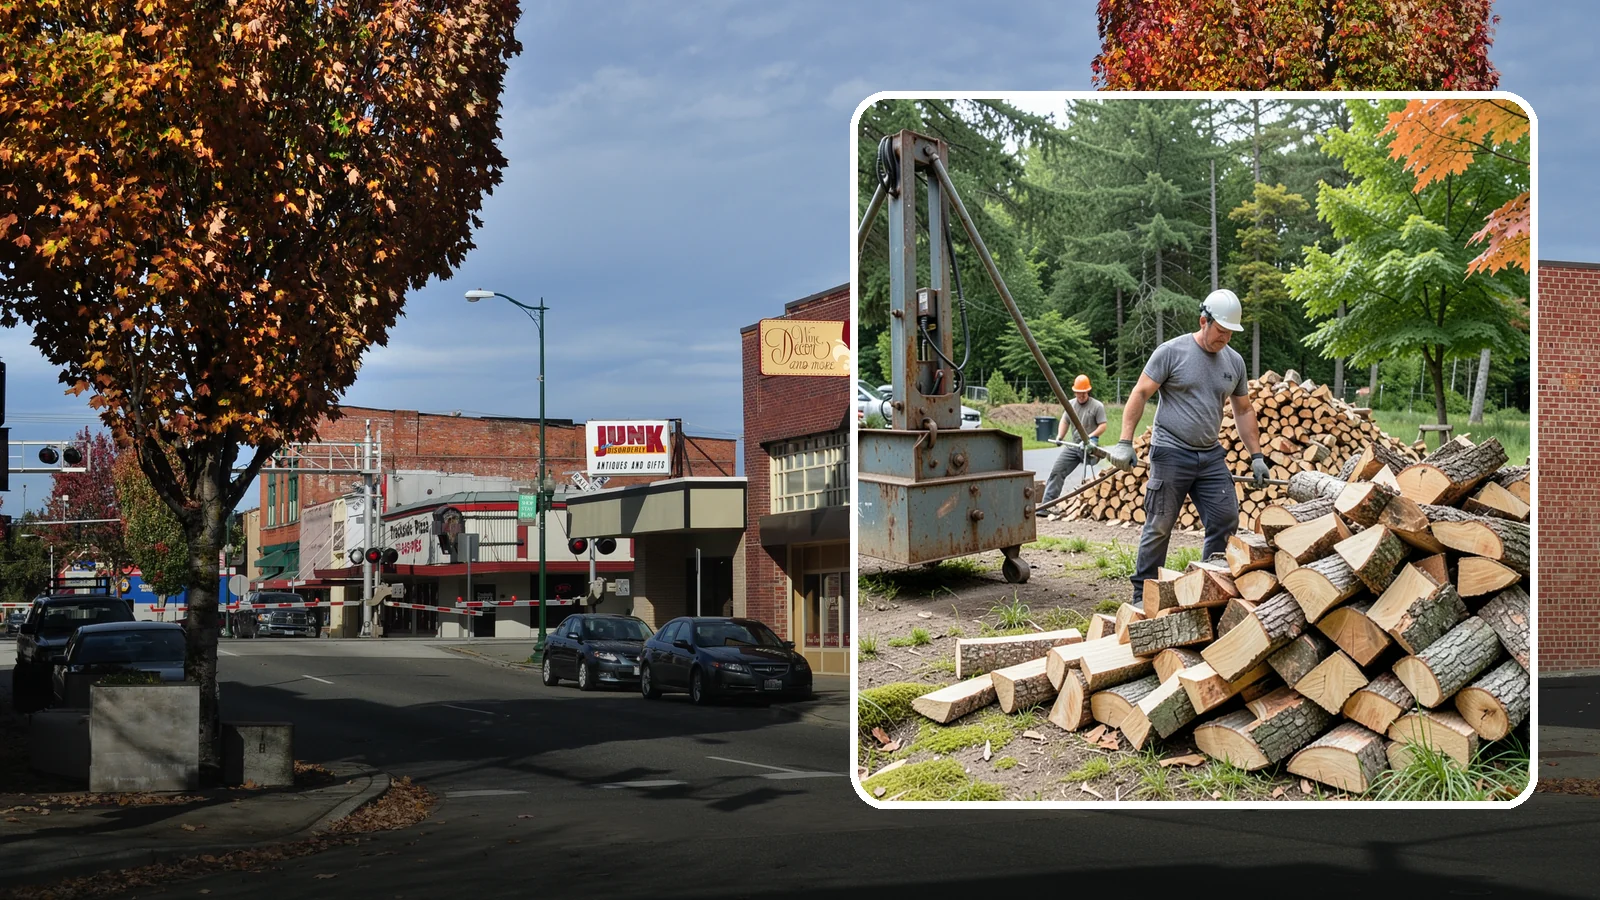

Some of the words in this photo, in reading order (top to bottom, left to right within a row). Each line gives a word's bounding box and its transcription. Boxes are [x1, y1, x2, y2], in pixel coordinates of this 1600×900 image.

[791, 325, 824, 345] Wine
[595, 425, 665, 457] JUNK
[607, 446, 646, 454] DISORDERLY
[597, 461, 628, 470] ANTIQUES
[631, 461, 644, 470] AND
[647, 460, 665, 469] GIFTS
[414, 519, 429, 534] Pizza
